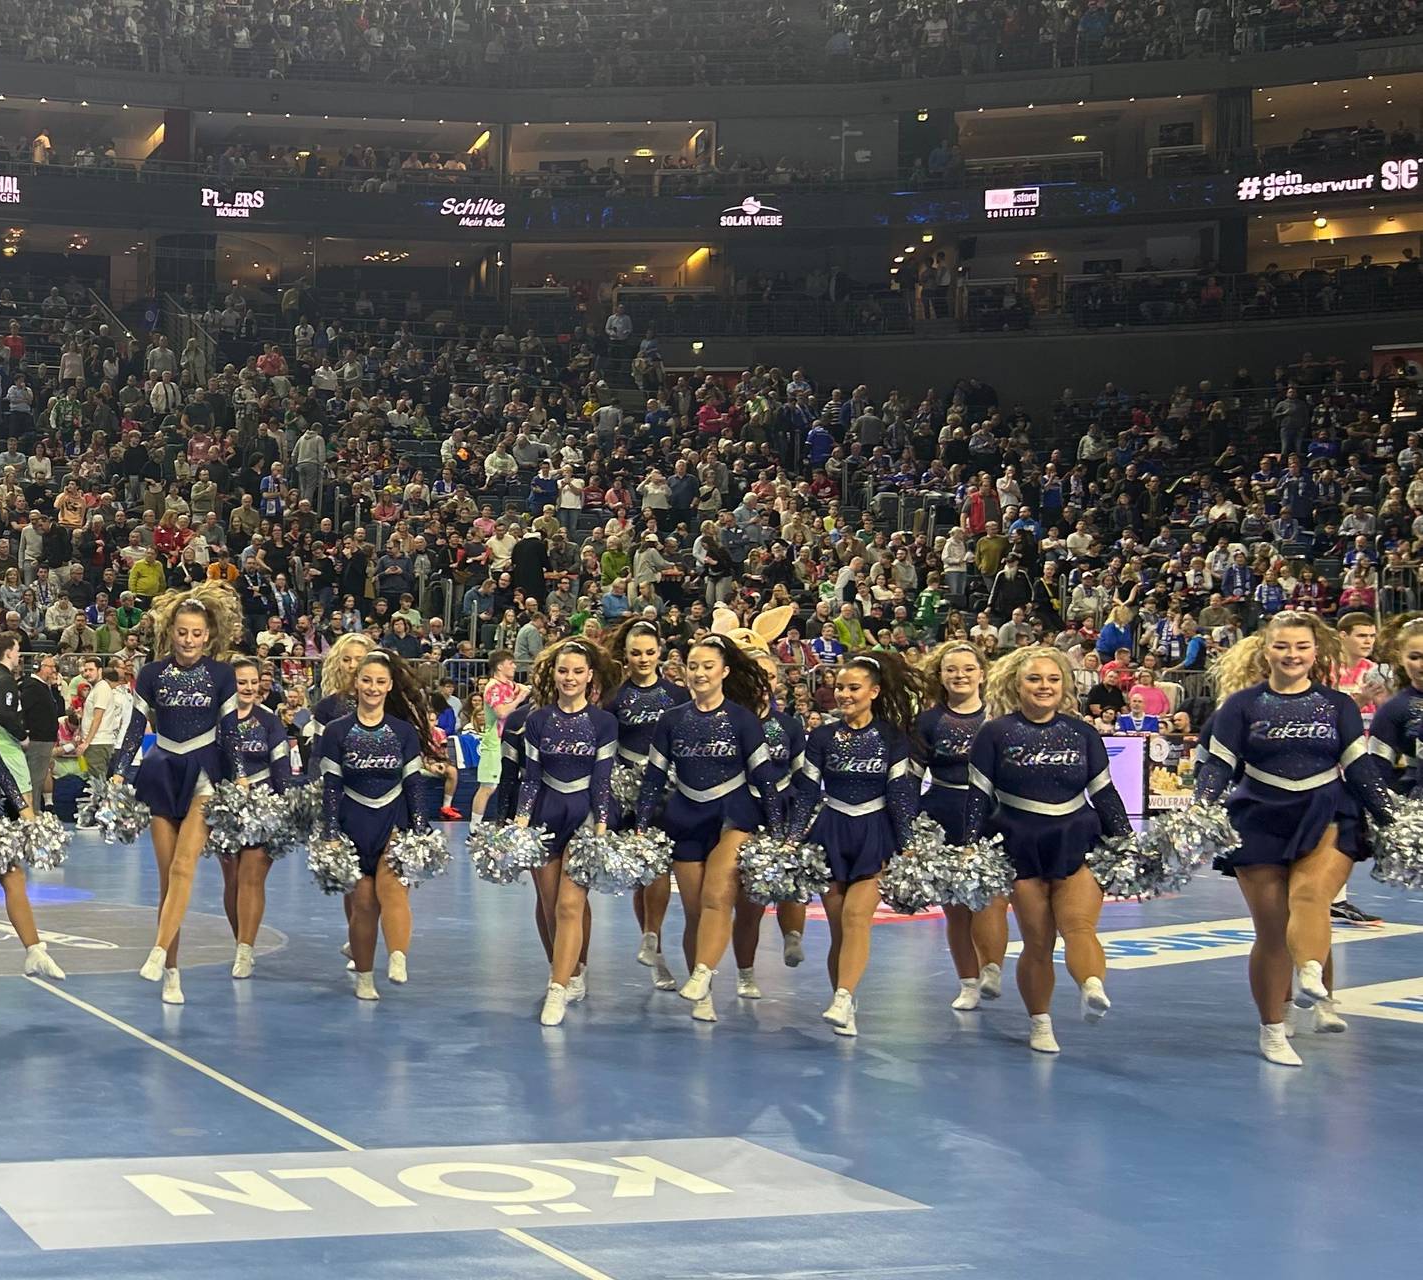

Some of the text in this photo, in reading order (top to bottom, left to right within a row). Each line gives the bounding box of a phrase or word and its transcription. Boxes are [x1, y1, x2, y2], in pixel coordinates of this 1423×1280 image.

[1263, 175, 1374, 201] grosserwurf
[440, 198, 505, 215] Schilke
[216, 207, 249, 217] KÖLSCH
[987, 208, 1036, 218] solutions
[459, 217, 505, 227] Mein Bad.
[720, 216, 782, 226] SOLAR WIEBE
[122, 1155, 735, 1216] KÖLN
